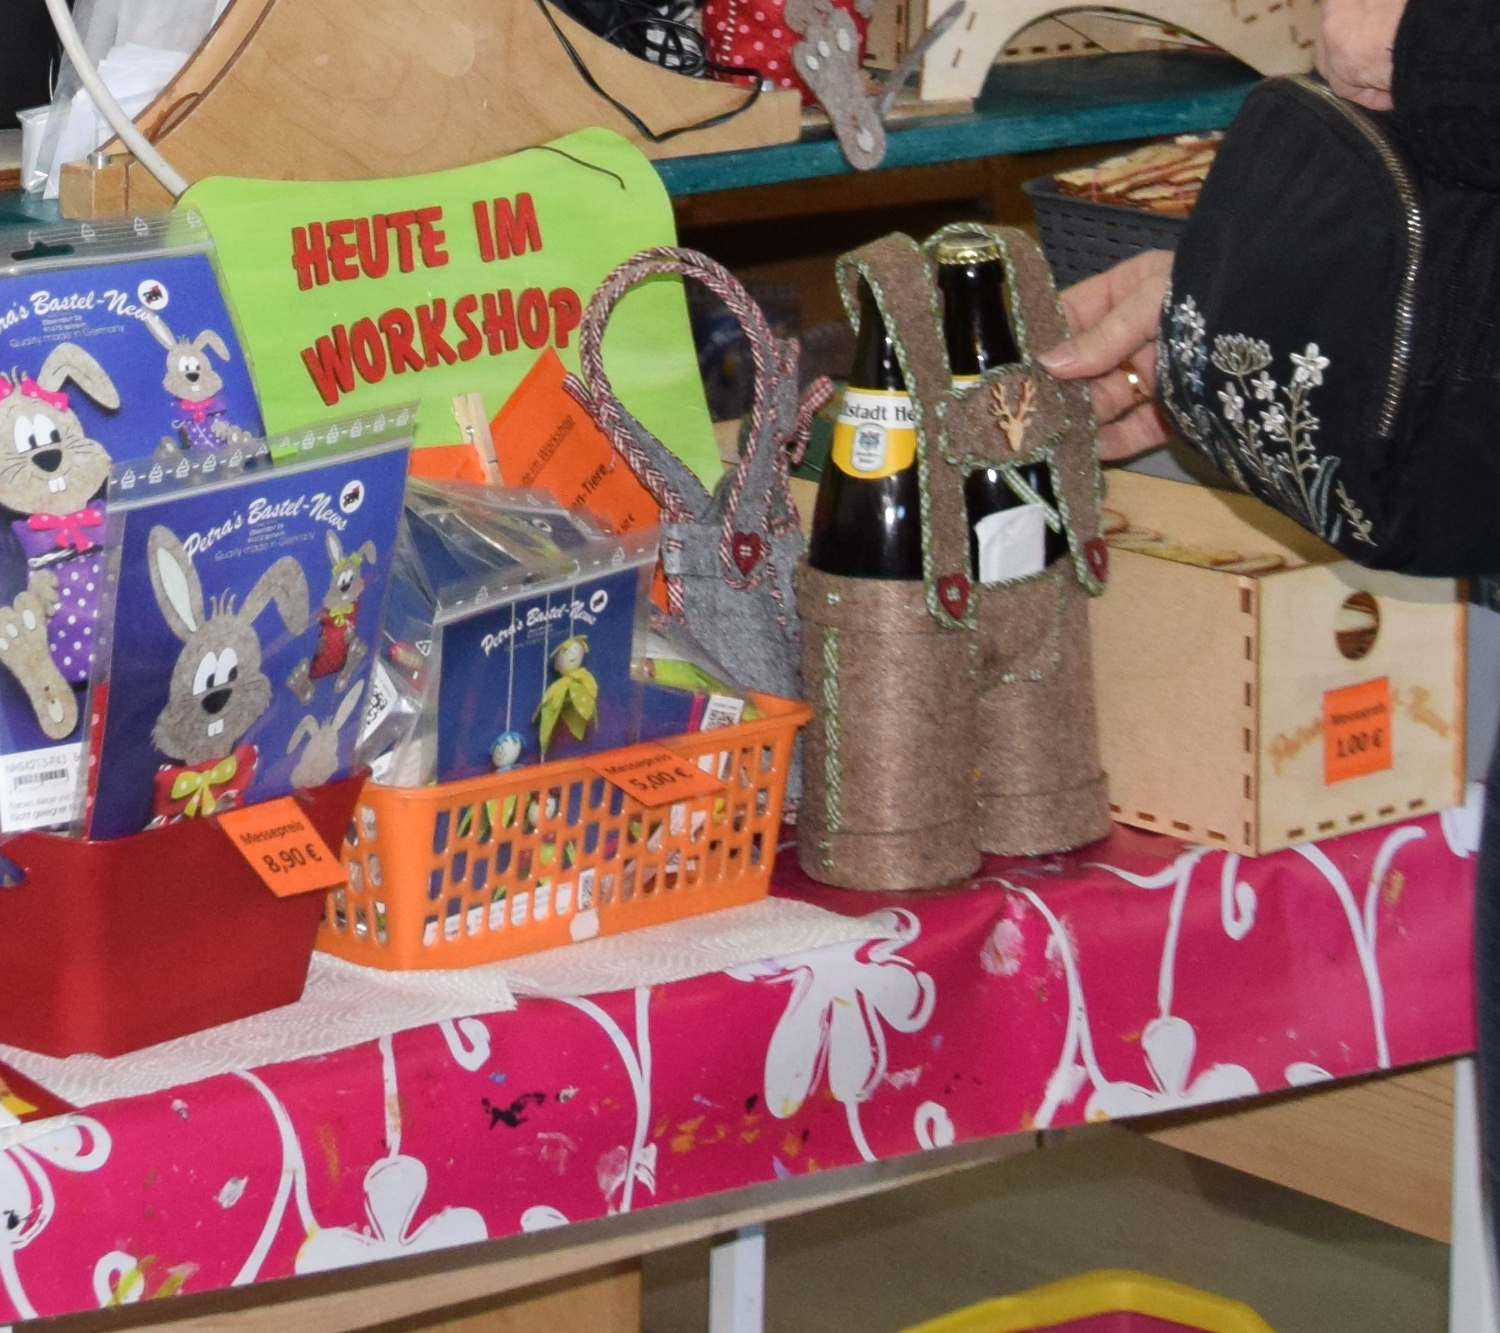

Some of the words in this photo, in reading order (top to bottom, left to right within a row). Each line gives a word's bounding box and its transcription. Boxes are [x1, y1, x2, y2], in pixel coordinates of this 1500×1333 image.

[291, 205, 449, 291] HEUTE
[472, 191, 544, 263] IM
[299, 286, 583, 407] WORKSHOP
[182, 510, 244, 565] Petra's
[247, 492, 348, 531] Bastel-News
[481, 618, 524, 657] Petra's
[628, 770, 677, 791] 5,00
[673, 767, 694, 780] €
[240, 820, 304, 845] Messepreis
[263, 847, 306, 874] 8,90
[305, 843, 322, 862] €
